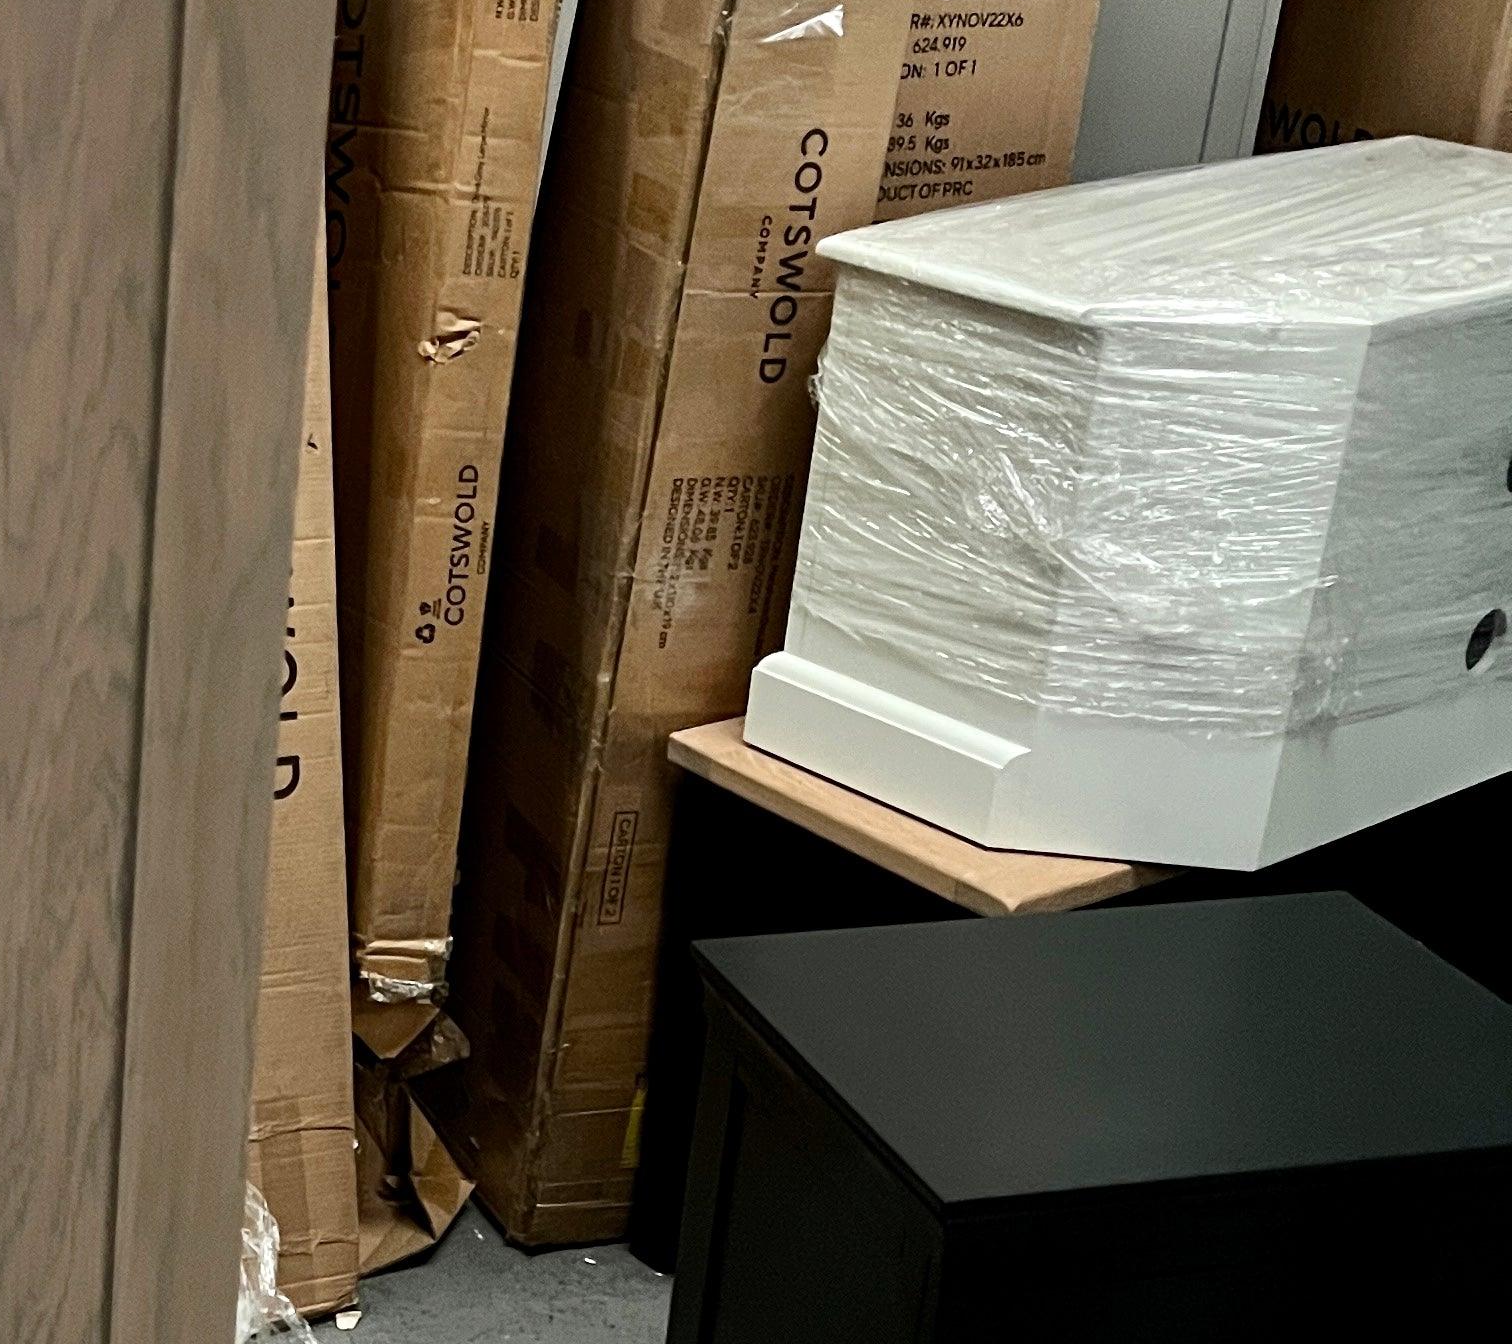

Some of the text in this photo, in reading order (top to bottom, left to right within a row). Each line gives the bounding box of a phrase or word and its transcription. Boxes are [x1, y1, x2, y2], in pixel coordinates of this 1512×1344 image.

[936, 11, 1024, 29] XYNOV22X6
[912, 36, 967, 54] 624.919
[945, 59, 968, 77] OF
[895, 110, 951, 130] 36 Kgs
[924, 135, 950, 154] Kgs
[918, 182, 941, 199] OF
[942, 180, 974, 197] PRC
[749, 215, 773, 299] COMPANY
[759, 128, 829, 384] COTSWOLD
[663, 477, 684, 544] DESIGNED
[443, 464, 479, 626] COTSWOLD
[477, 520, 489, 575] COMPANY
[610, 819, 632, 876] CARTON
